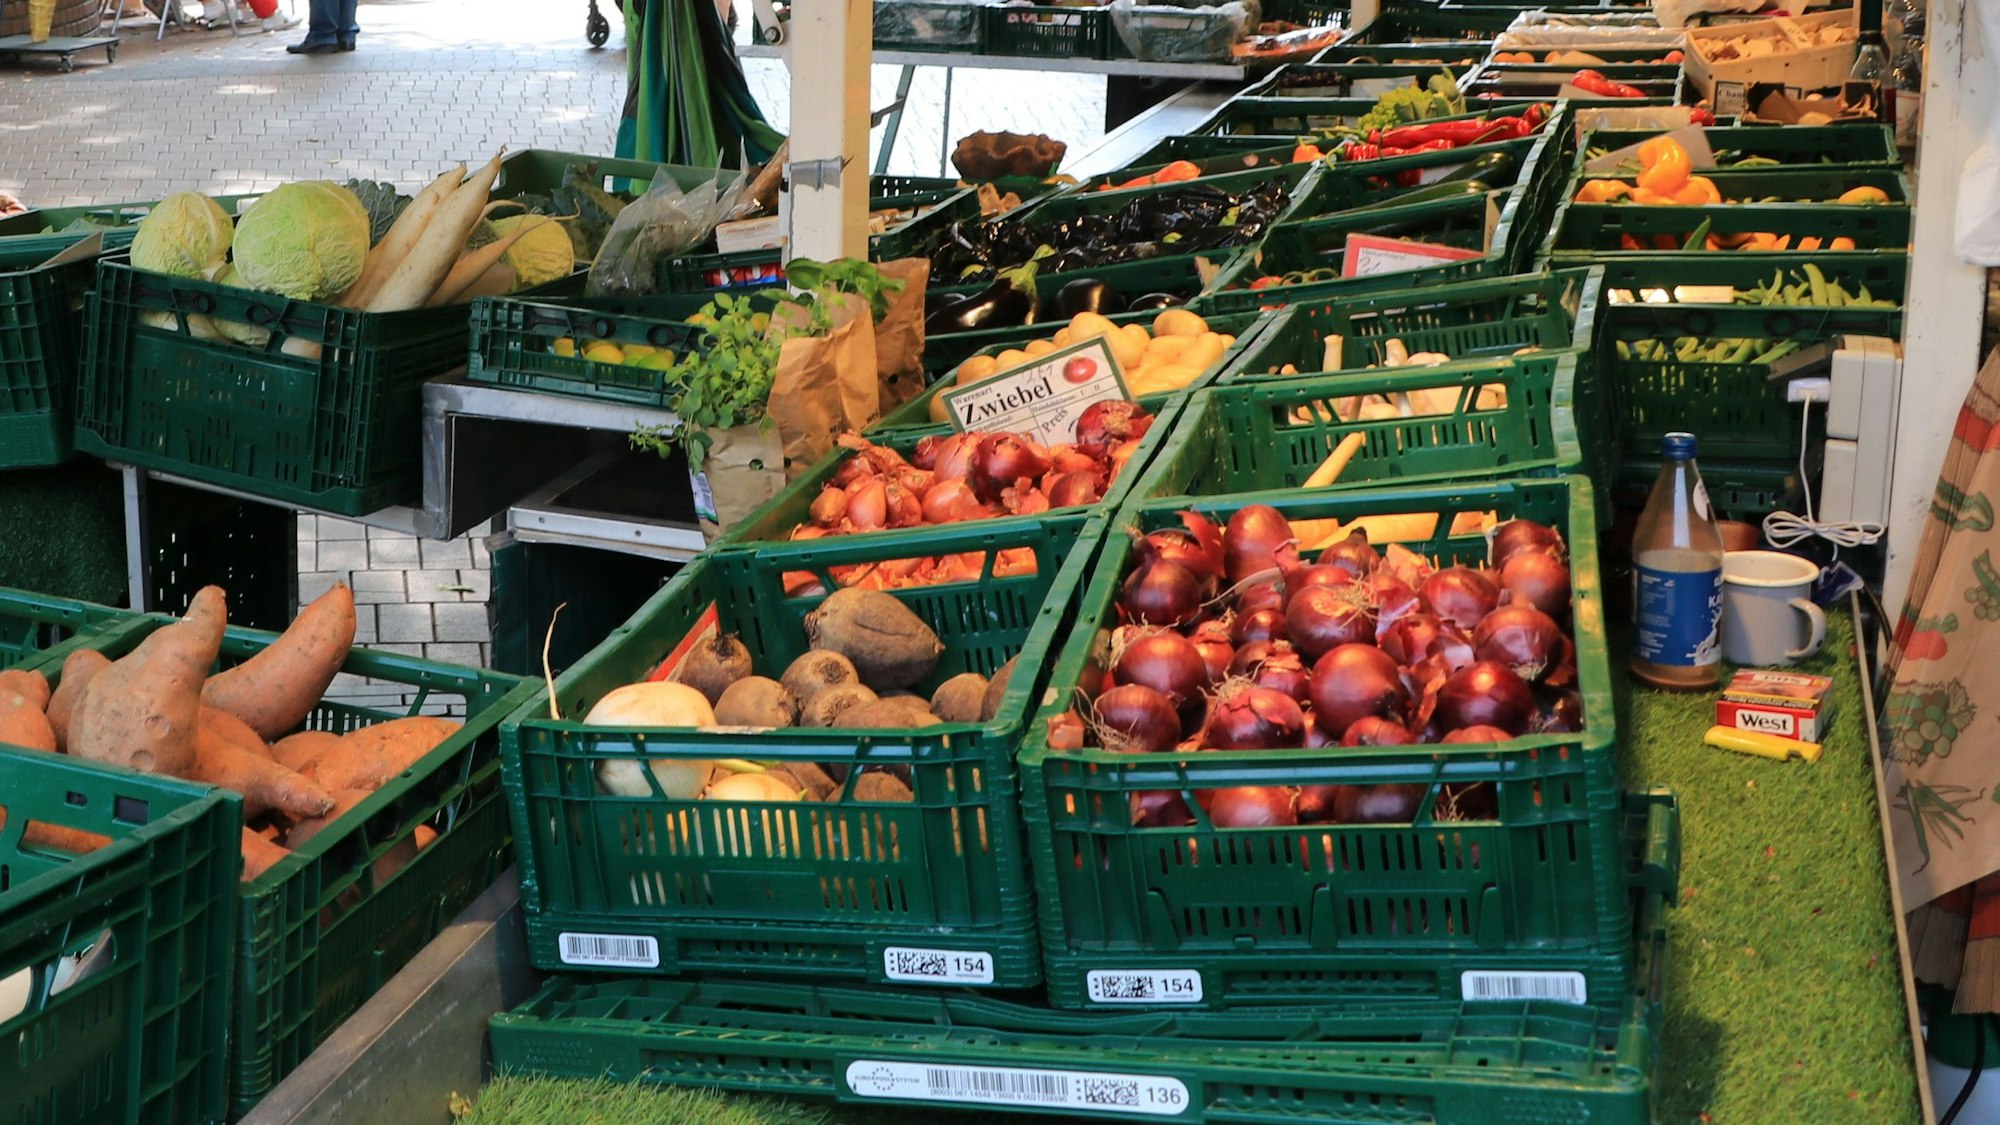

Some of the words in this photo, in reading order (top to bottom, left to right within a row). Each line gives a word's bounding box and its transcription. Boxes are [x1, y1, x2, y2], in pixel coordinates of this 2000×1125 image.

[953, 387, 993, 405] Warenart
[960, 377, 1053, 425] Zwiebel
[1041, 407, 1069, 433] Preis
[1740, 712, 1790, 731] West
[953, 957, 985, 972] 154
[1161, 978, 1194, 992] 154
[1145, 1086, 1182, 1105] 136
